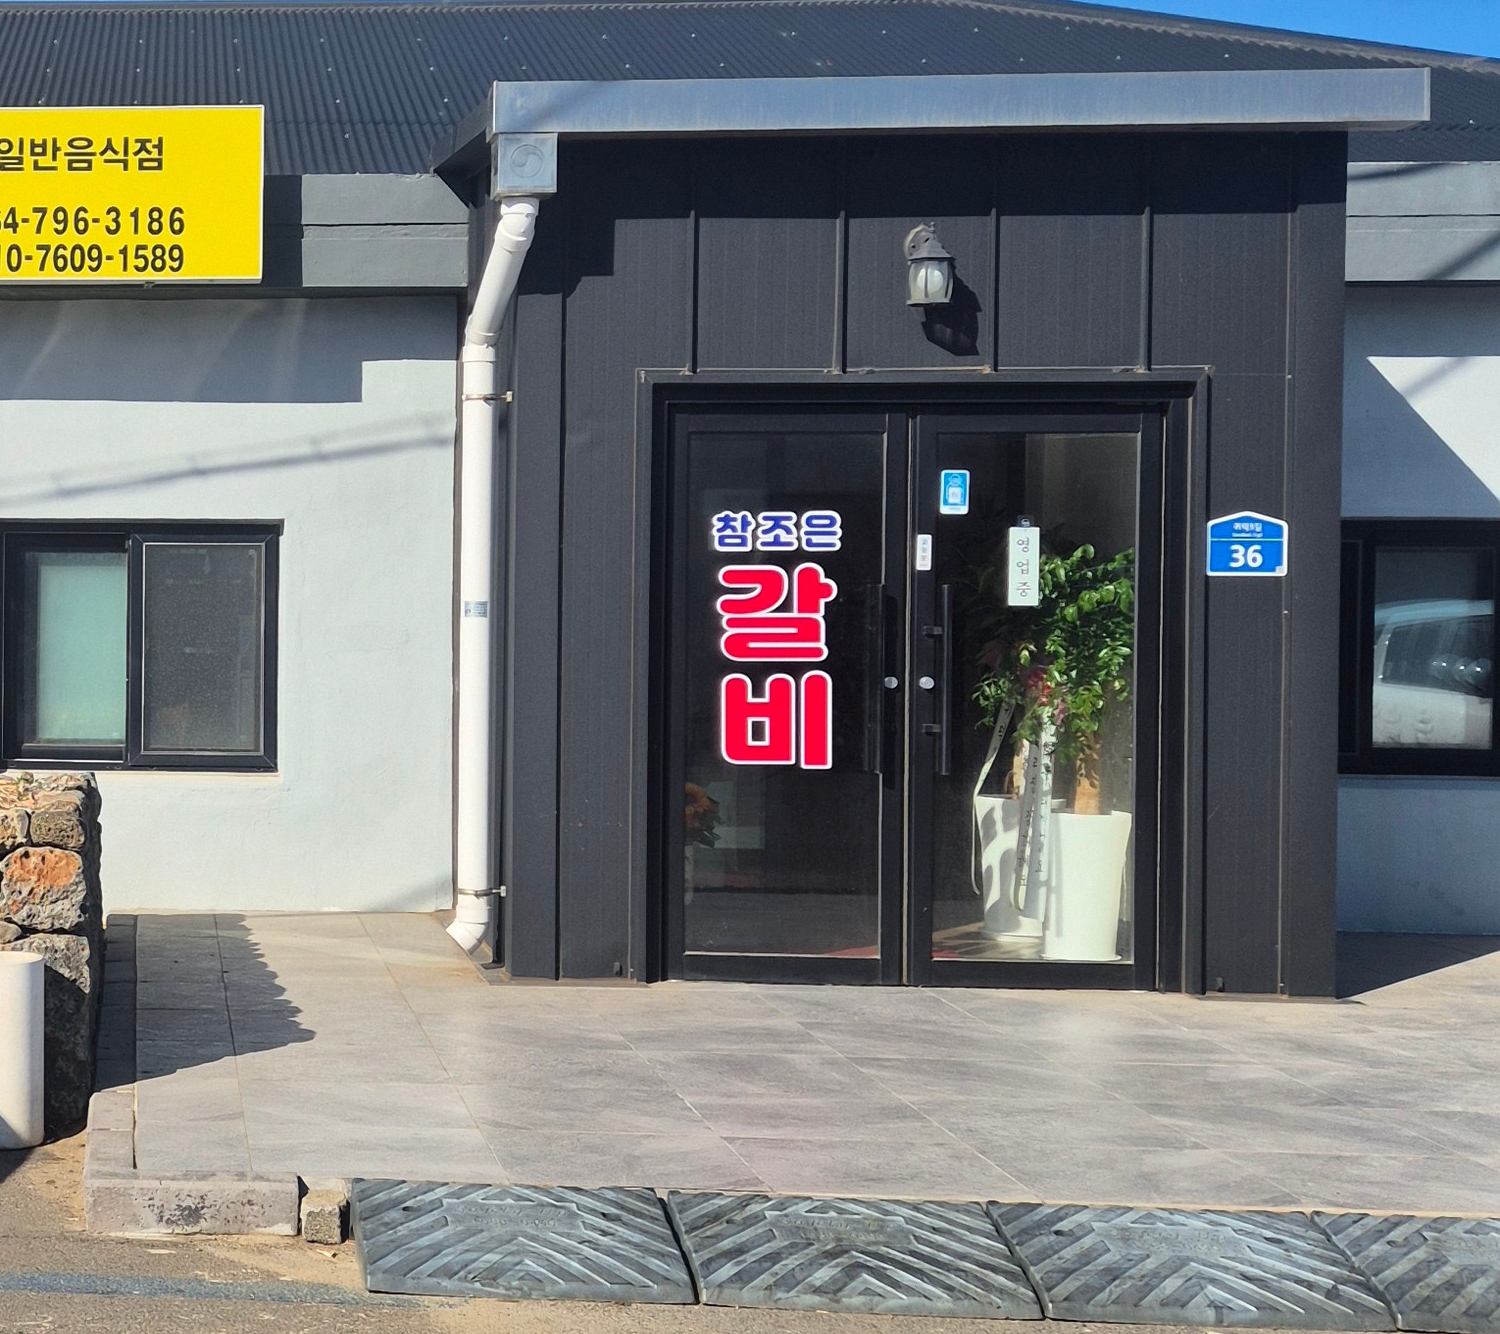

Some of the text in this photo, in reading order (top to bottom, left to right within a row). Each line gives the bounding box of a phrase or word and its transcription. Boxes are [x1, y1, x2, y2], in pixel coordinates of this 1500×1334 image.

[711, 510, 843, 553] 참조은
[1016, 536, 1032, 598] 영업중
[1229, 544, 1264, 568] 36
